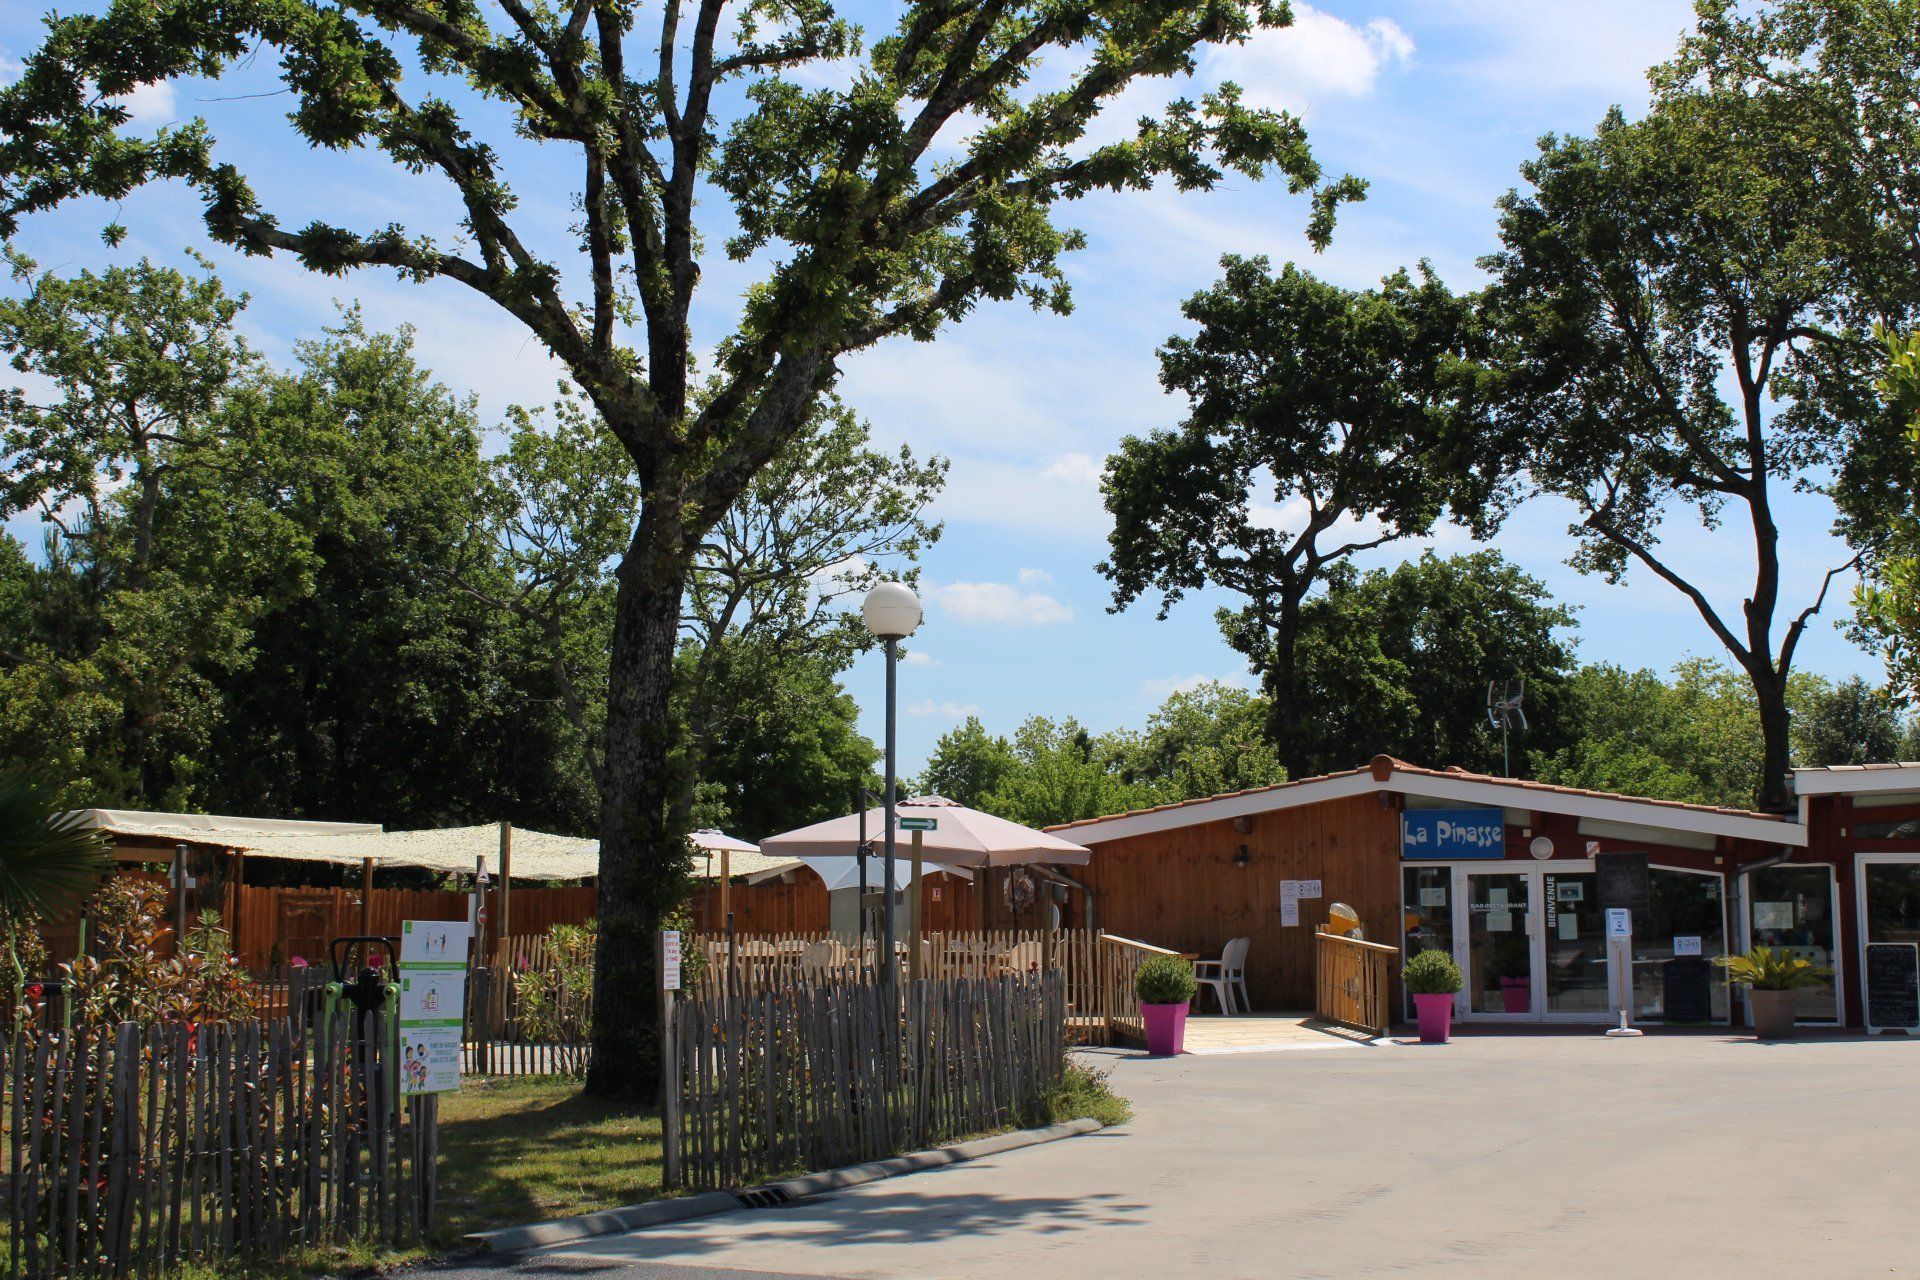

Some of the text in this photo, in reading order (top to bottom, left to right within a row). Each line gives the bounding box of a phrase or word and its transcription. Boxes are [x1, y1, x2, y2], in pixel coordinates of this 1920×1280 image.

[1404, 820, 1502, 847] La Pinasse
[1546, 876, 1556, 927] BIENVENUE
